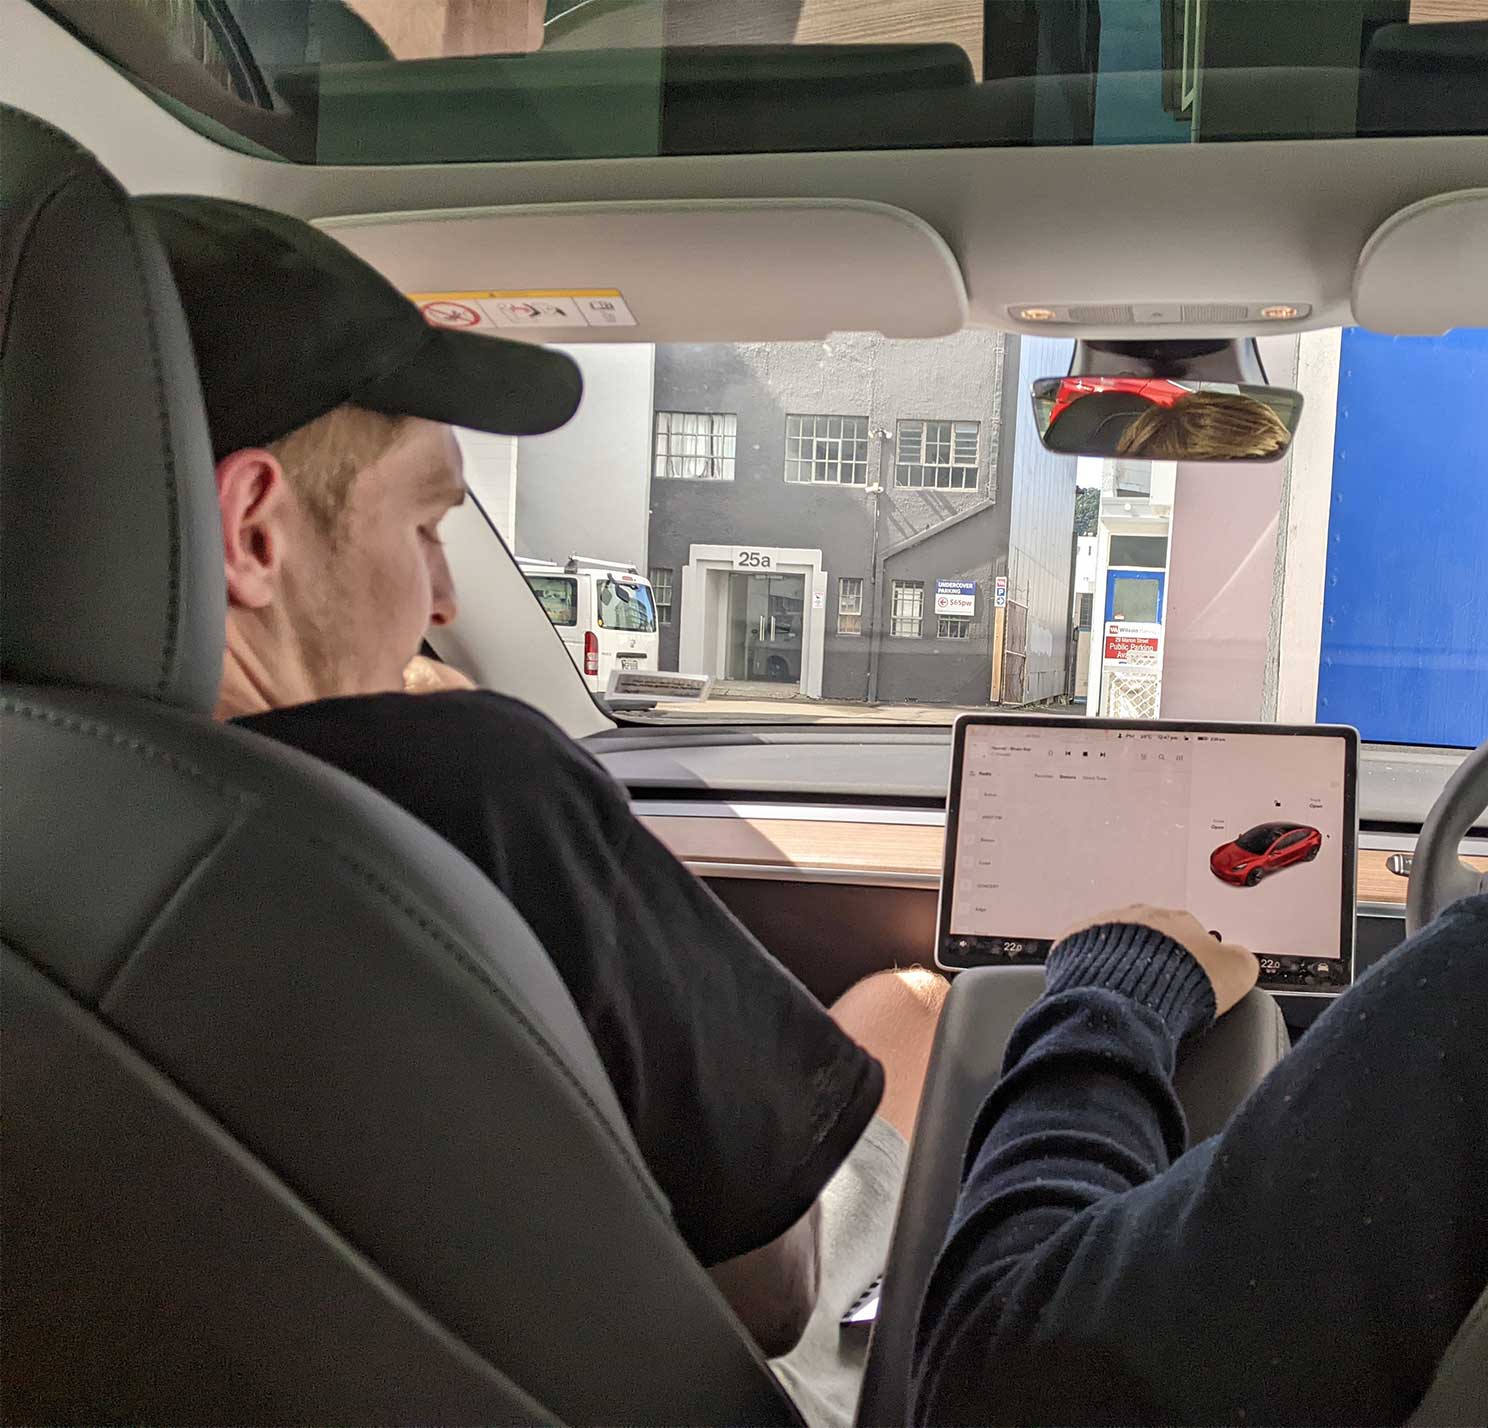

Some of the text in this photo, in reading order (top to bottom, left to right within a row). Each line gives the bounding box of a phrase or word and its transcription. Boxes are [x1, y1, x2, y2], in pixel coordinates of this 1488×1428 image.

[738, 551, 770, 568] 25a
[938, 581, 974, 589] UNDERCOVER
[950, 598, 972, 607] $65pw
[1109, 642, 1154, 652] Public Parking
